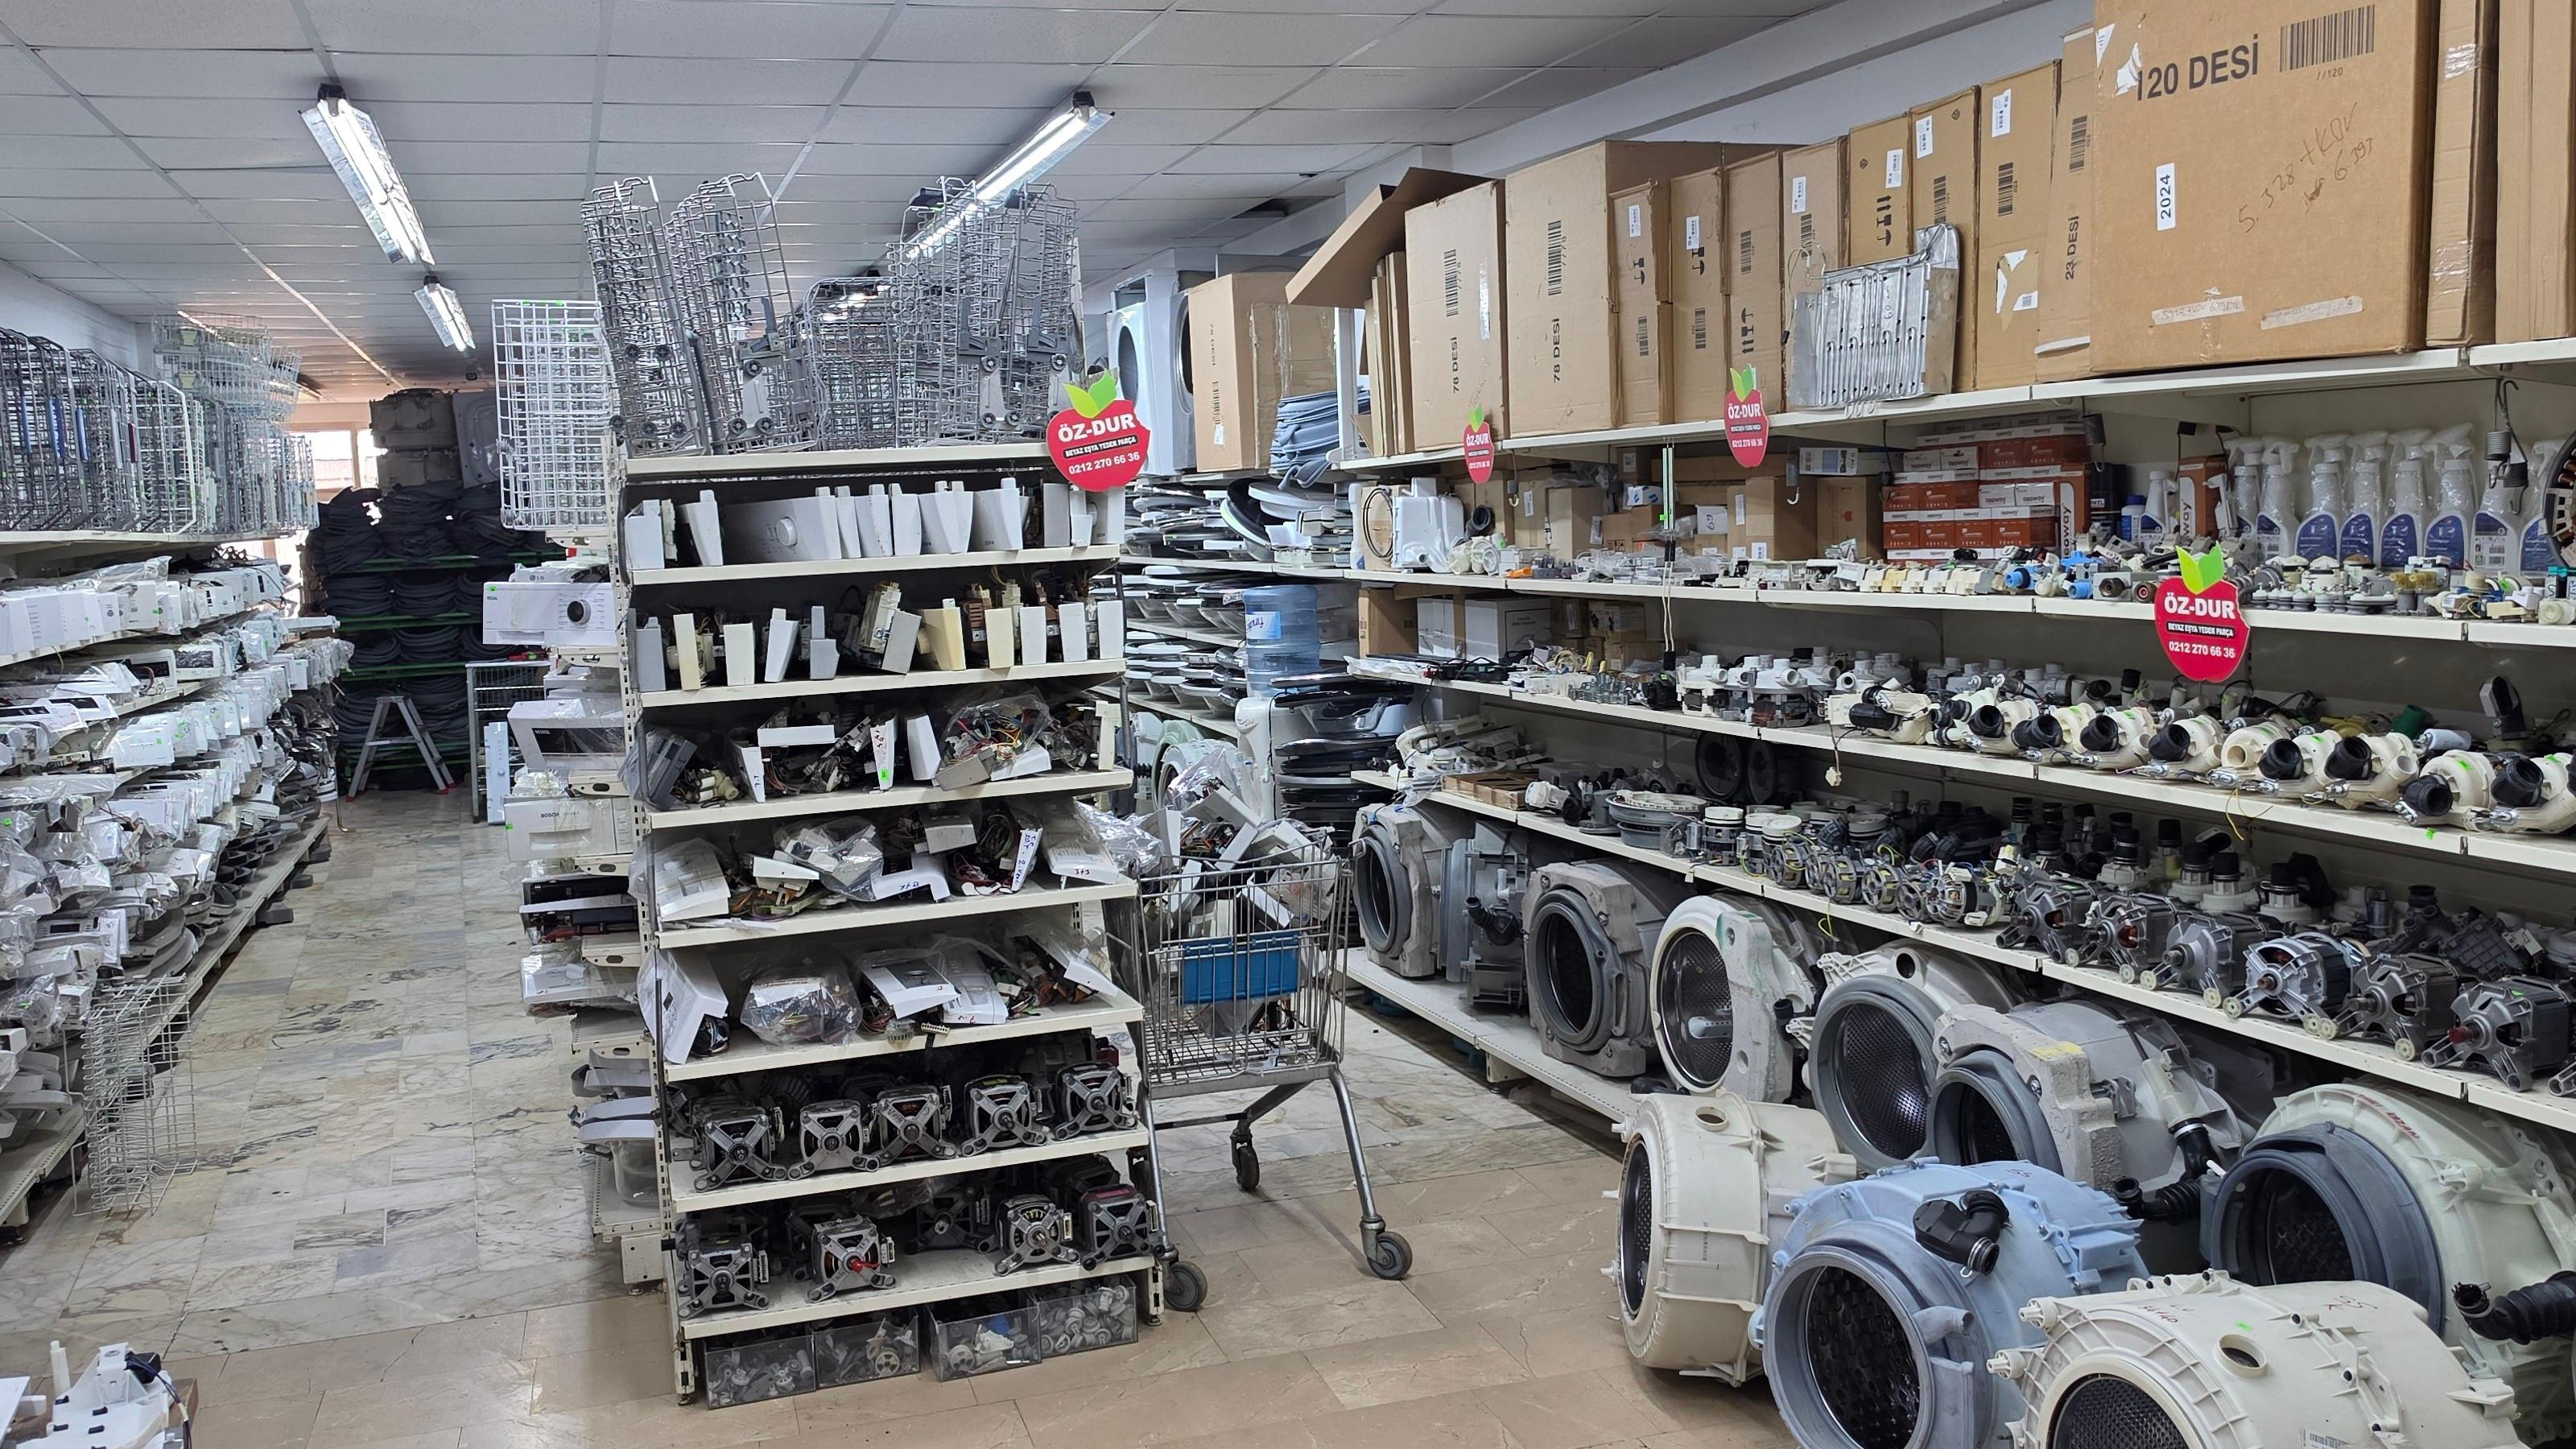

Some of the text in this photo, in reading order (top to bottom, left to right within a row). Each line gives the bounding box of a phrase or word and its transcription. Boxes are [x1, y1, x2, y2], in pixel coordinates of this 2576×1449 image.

[2137, 33, 2258, 101] 120 DESİ
[2159, 174, 2172, 220] 2024
[1553, 364, 1561, 383] 78
[1452, 377, 1459, 394] 78
[1728, 403, 1761, 419] ÖZ-DUR
[1058, 413, 1136, 443] ÖZ-DUR
[1466, 432, 1489, 447] ÖZ-DUR
[1068, 452, 1140, 474] 0212 270 66 36
[1985, 494, 2046, 505] neoway neoway
[2063, 506, 2072, 556] eoway
[2164, 592, 2235, 620] ÖZ-DUR
[2169, 641, 2235, 658] 0212 270 66 36
